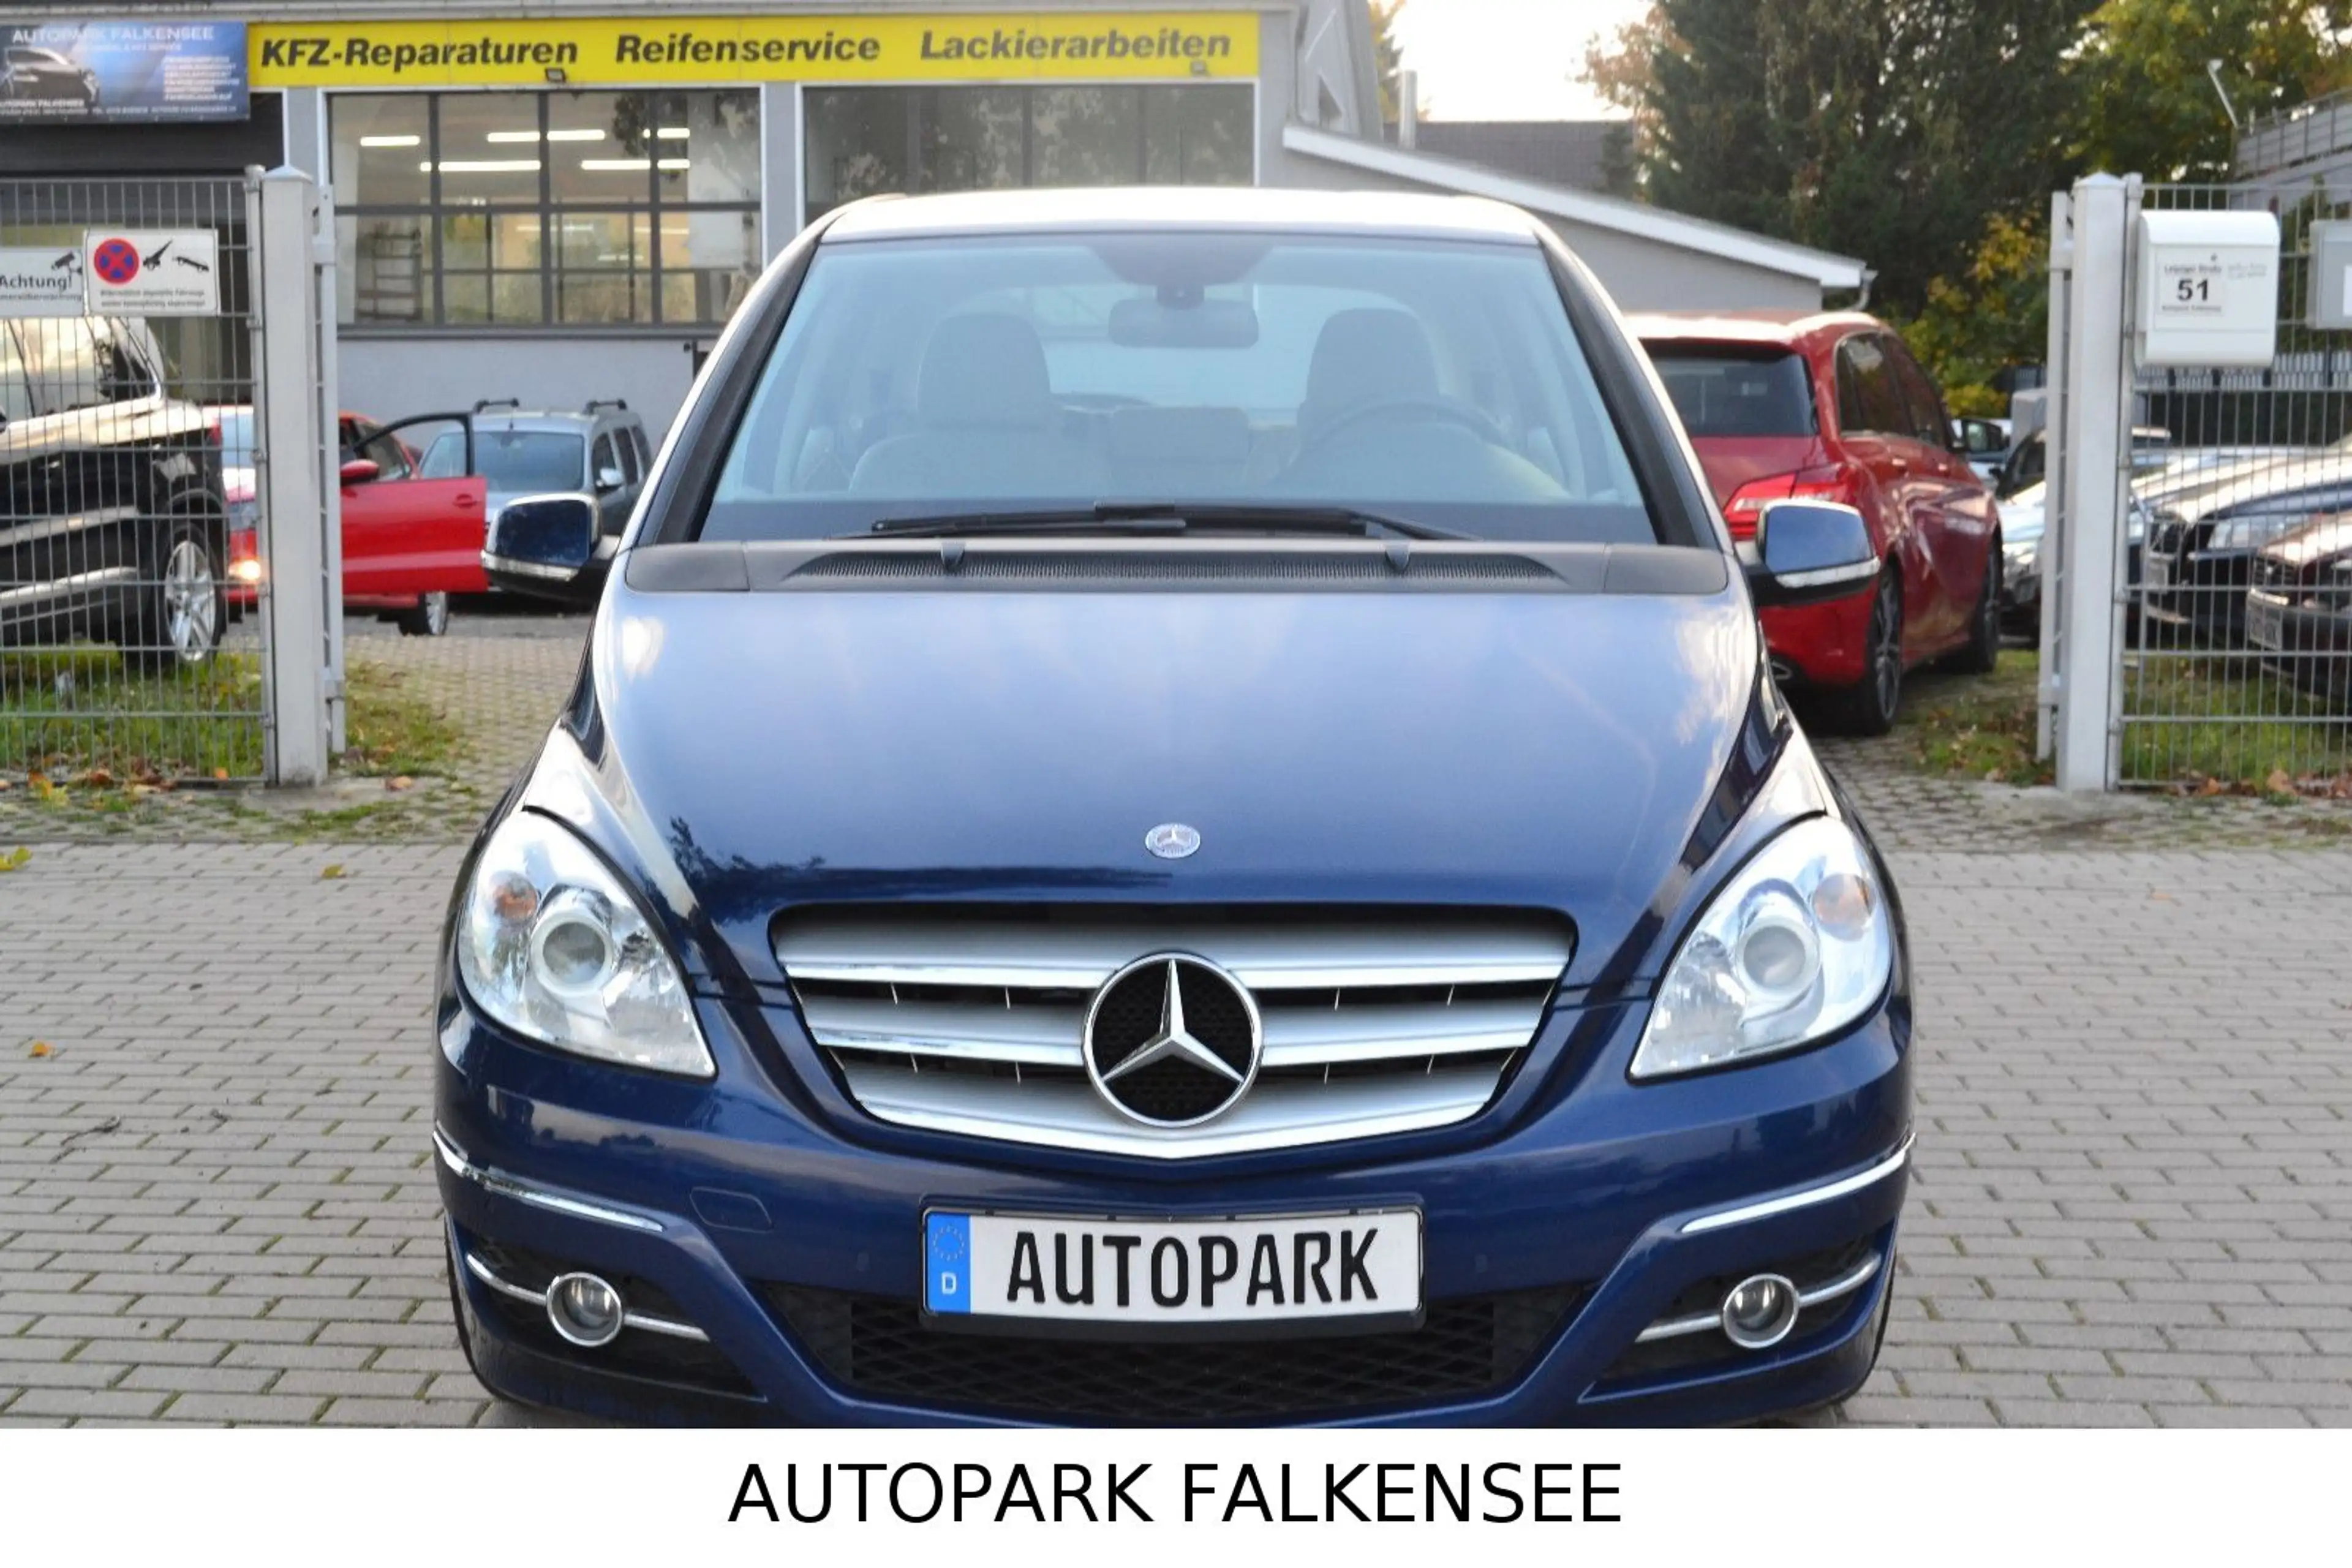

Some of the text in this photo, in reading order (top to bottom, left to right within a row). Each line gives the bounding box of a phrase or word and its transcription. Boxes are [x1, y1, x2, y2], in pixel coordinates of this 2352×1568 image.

[12, 26, 214, 43] AUTOPARK FALKENSEE
[262, 28, 1232, 72] KFZ-Reparaturen Reifenservice Lackierarbeiten
[0, 274, 72, 292] Achtung!
[2177, 279, 2209, 301] 51
[1006, 1227, 1378, 1308] AUTOPARK
[941, 1272, 957, 1294] D
